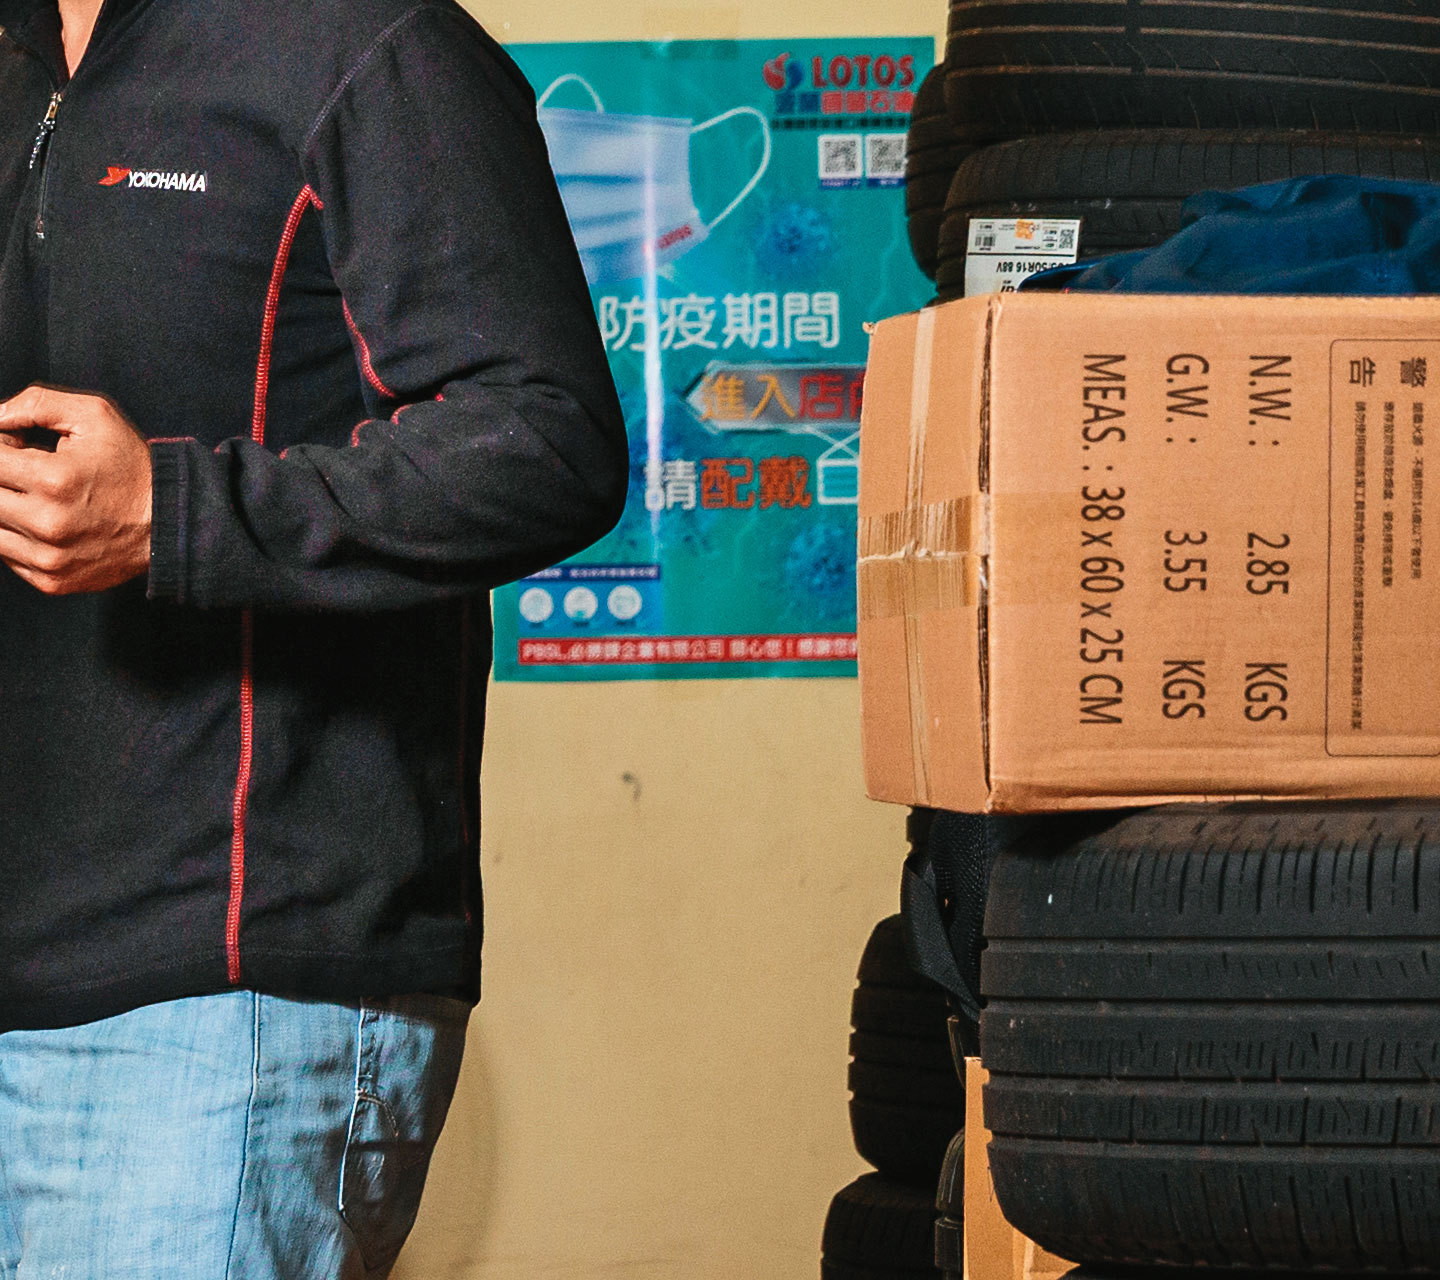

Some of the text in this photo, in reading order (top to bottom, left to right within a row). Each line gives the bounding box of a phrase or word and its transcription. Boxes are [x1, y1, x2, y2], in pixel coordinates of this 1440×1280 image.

[812, 54, 915, 89] LOTOS
[127, 170, 207, 193] YOKOHAMA
[601, 292, 840, 352] 防疫期間
[1349, 356, 1427, 388] 警告
[644, 456, 812, 511] 請配戴
[1081, 486, 1126, 521] 38
[1081, 531, 1114, 548] x
[1081, 556, 1125, 593] 60
[1164, 529, 1208, 592] 3.55
[1246, 531, 1290, 596] 2.85
[1080, 602, 1113, 618] x
[1080, 628, 1124, 663] 25
[1079, 673, 1124, 724] CM
[1162, 659, 1206, 720] KGS
[1244, 662, 1288, 722] KGS
